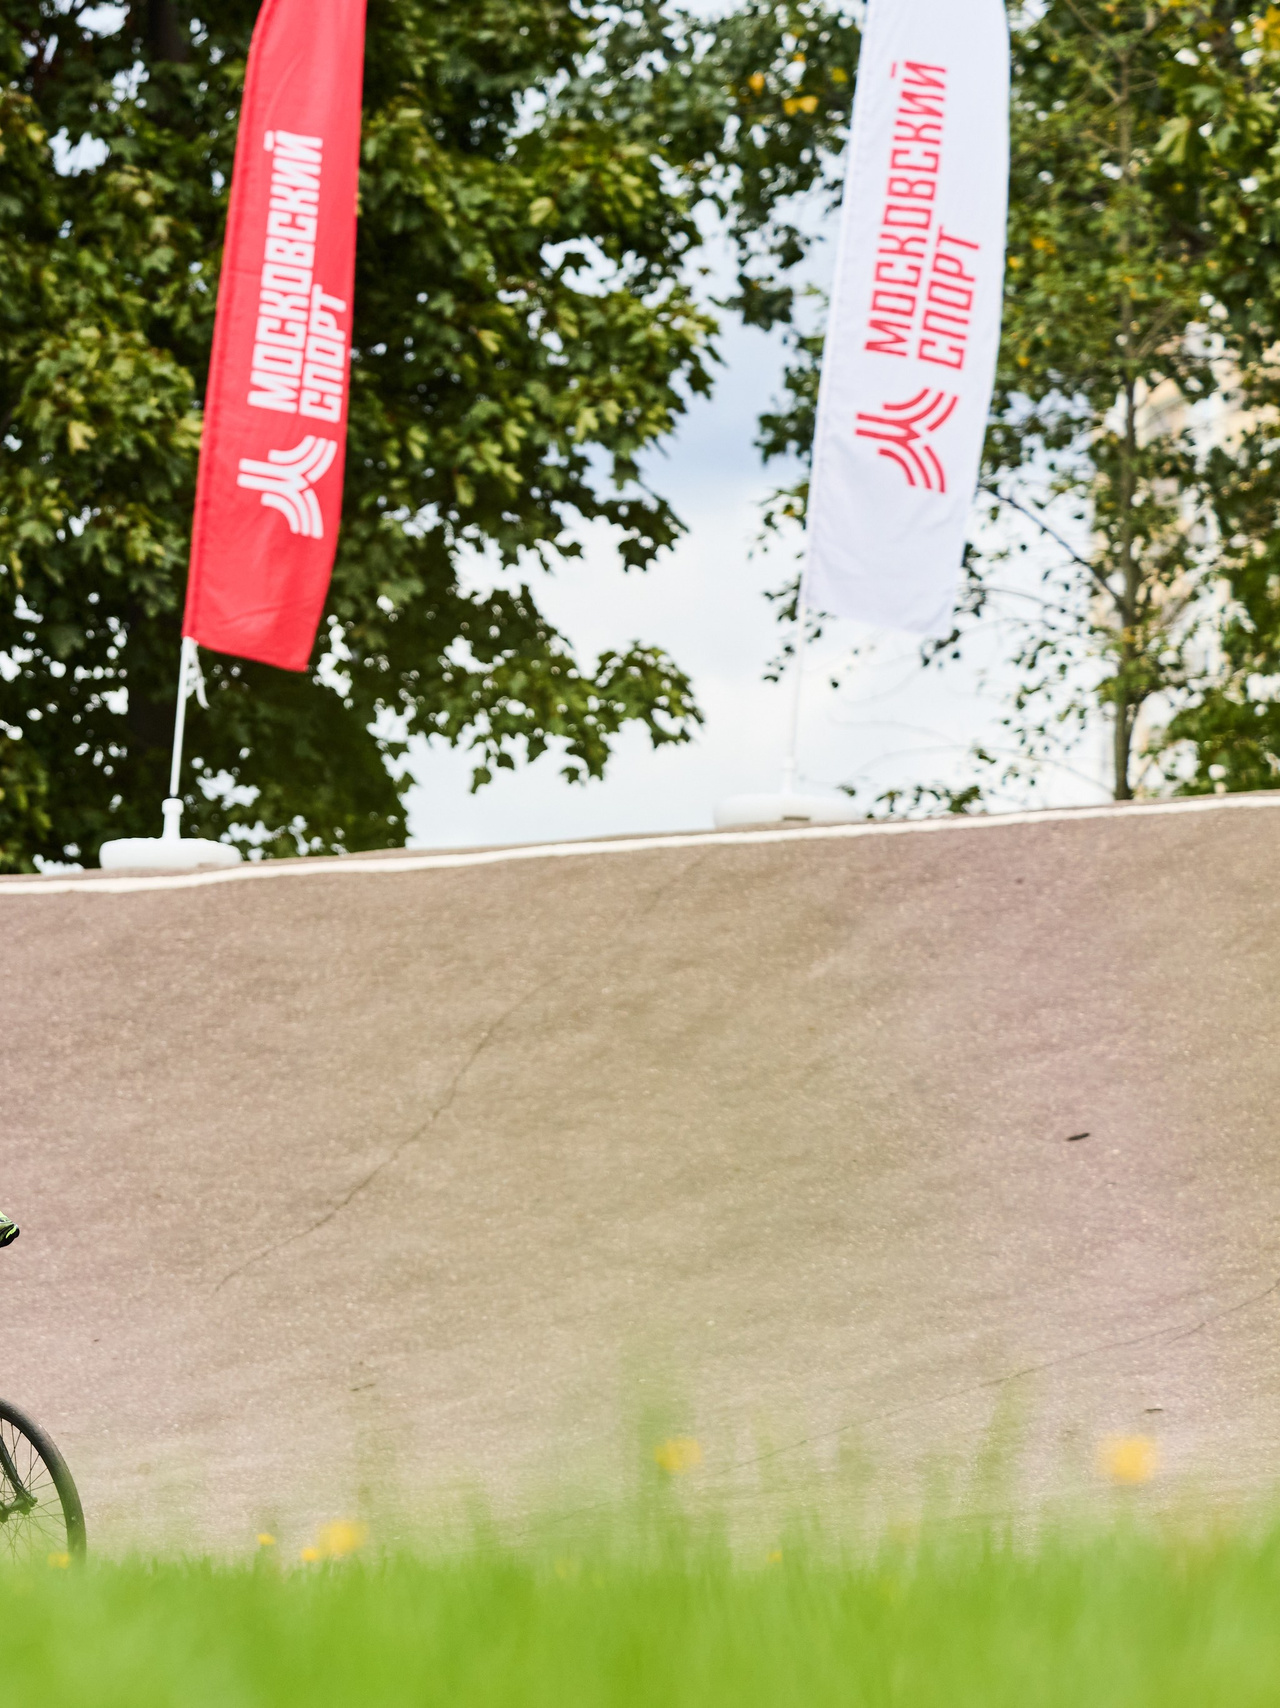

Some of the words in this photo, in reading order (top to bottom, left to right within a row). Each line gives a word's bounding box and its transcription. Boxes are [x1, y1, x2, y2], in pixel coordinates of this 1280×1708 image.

[247, 130, 323, 414] МОСКОВСКИЙ
[865, 60, 947, 357] МОСКОВСКИЙ
[917, 225, 980, 370] СПОРТ
[299, 284, 347, 423] СПОРТ
